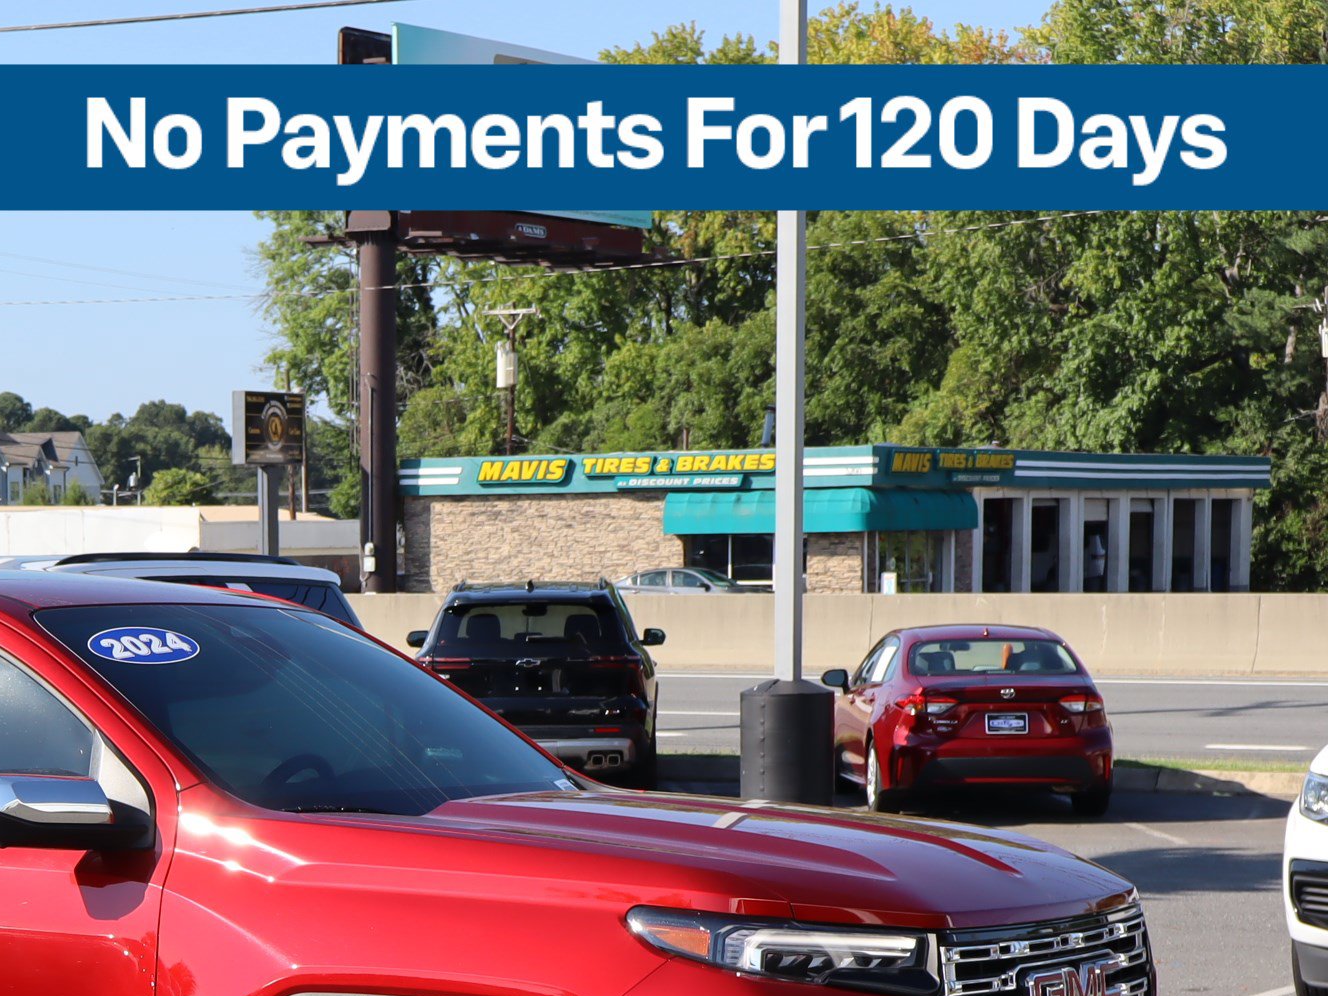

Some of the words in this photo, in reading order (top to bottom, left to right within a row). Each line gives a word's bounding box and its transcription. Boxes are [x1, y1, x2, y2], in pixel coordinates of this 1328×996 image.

[478, 458, 566, 482] MAVIS
[582, 456, 651, 474] TIRES
[655, 456, 671, 473] &
[676, 453, 776, 472] BRAKES
[892, 452, 932, 473] MAVIS
[939, 453, 967, 469] TIRES
[628, 478, 690, 486] DISCOUNT
[692, 477, 740, 486] PRICES
[100, 632, 192, 659] 2024
